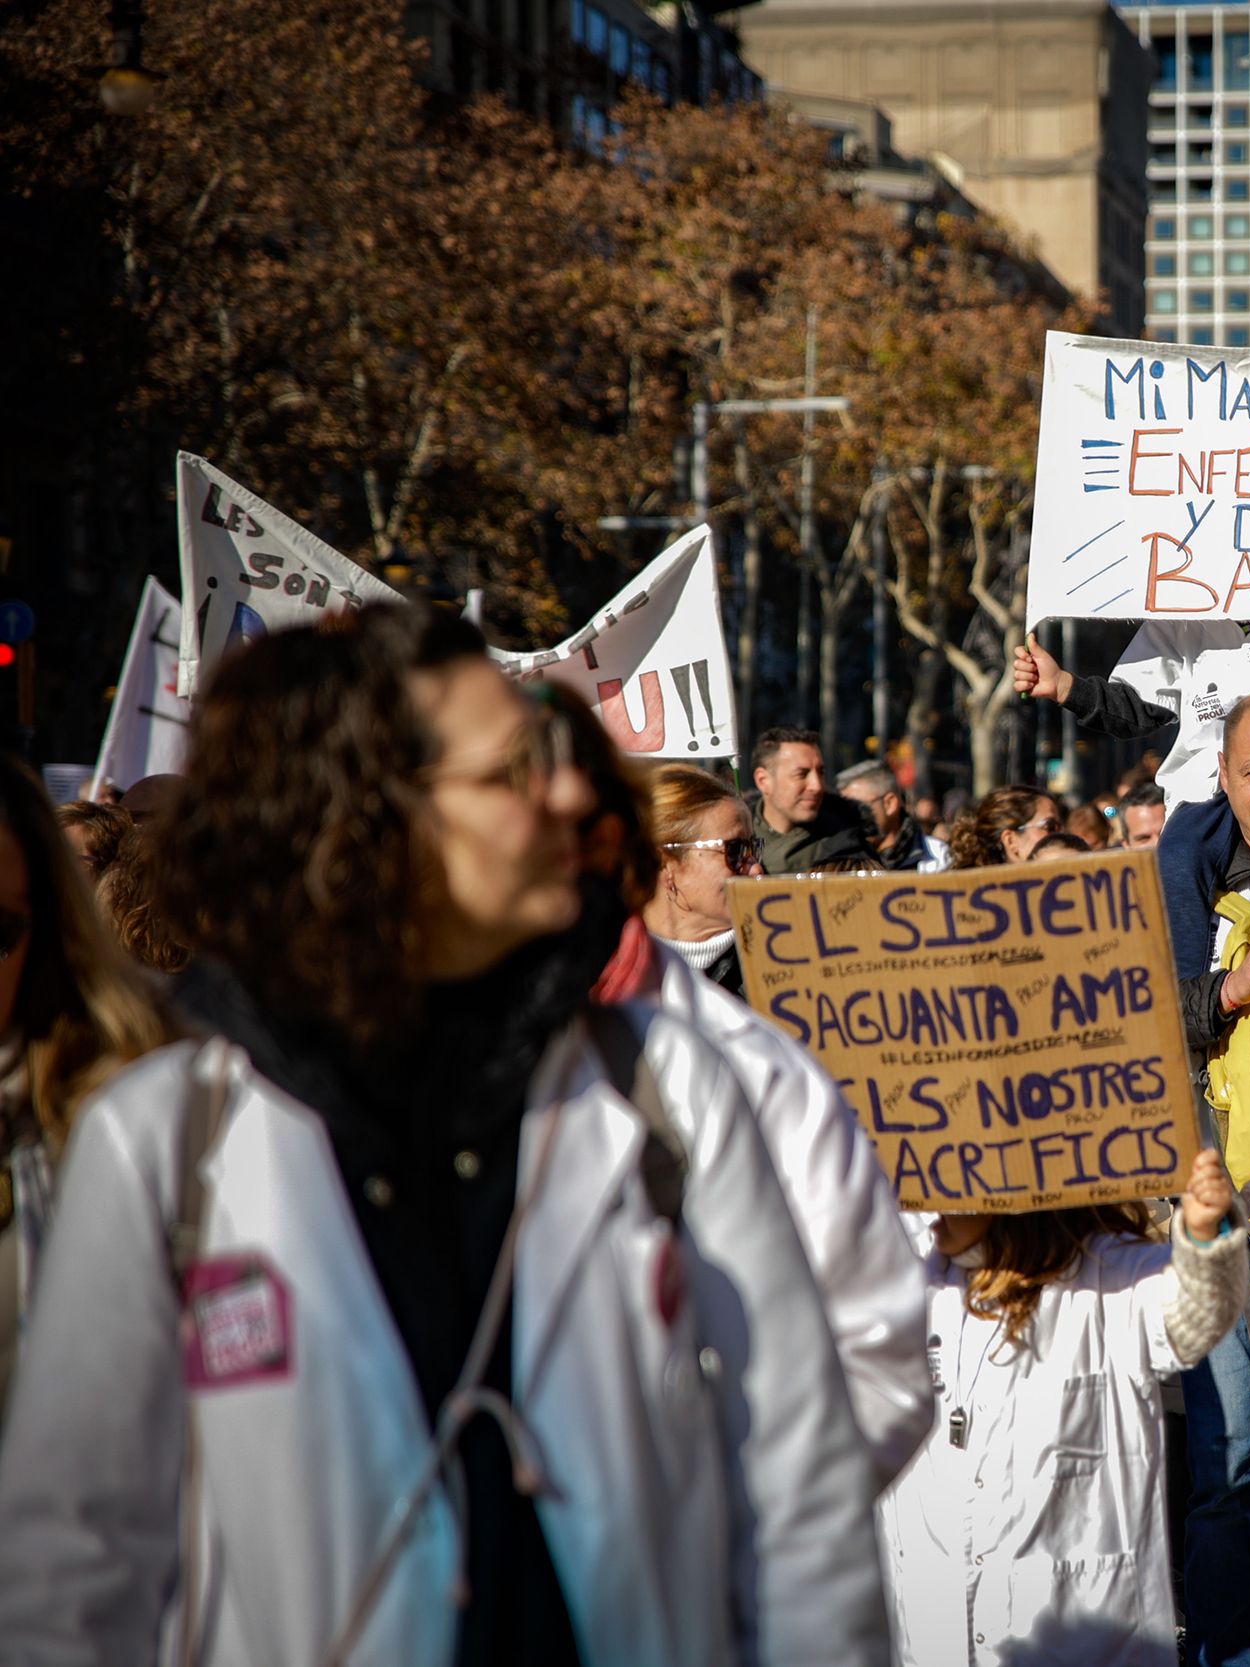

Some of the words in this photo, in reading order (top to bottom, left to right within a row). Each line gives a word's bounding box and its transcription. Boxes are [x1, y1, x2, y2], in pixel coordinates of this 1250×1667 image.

[201, 482, 265, 538] LES
[756, 893, 859, 965] EL
[880, 865, 1148, 952] SISTEMA
[770, 983, 1019, 1050] S'AGUANTA
[1051, 966, 1154, 1032] AMB
[976, 1056, 1166, 1129] NOSTRES
[870, 1120, 1178, 1200] ACRIFICIS
